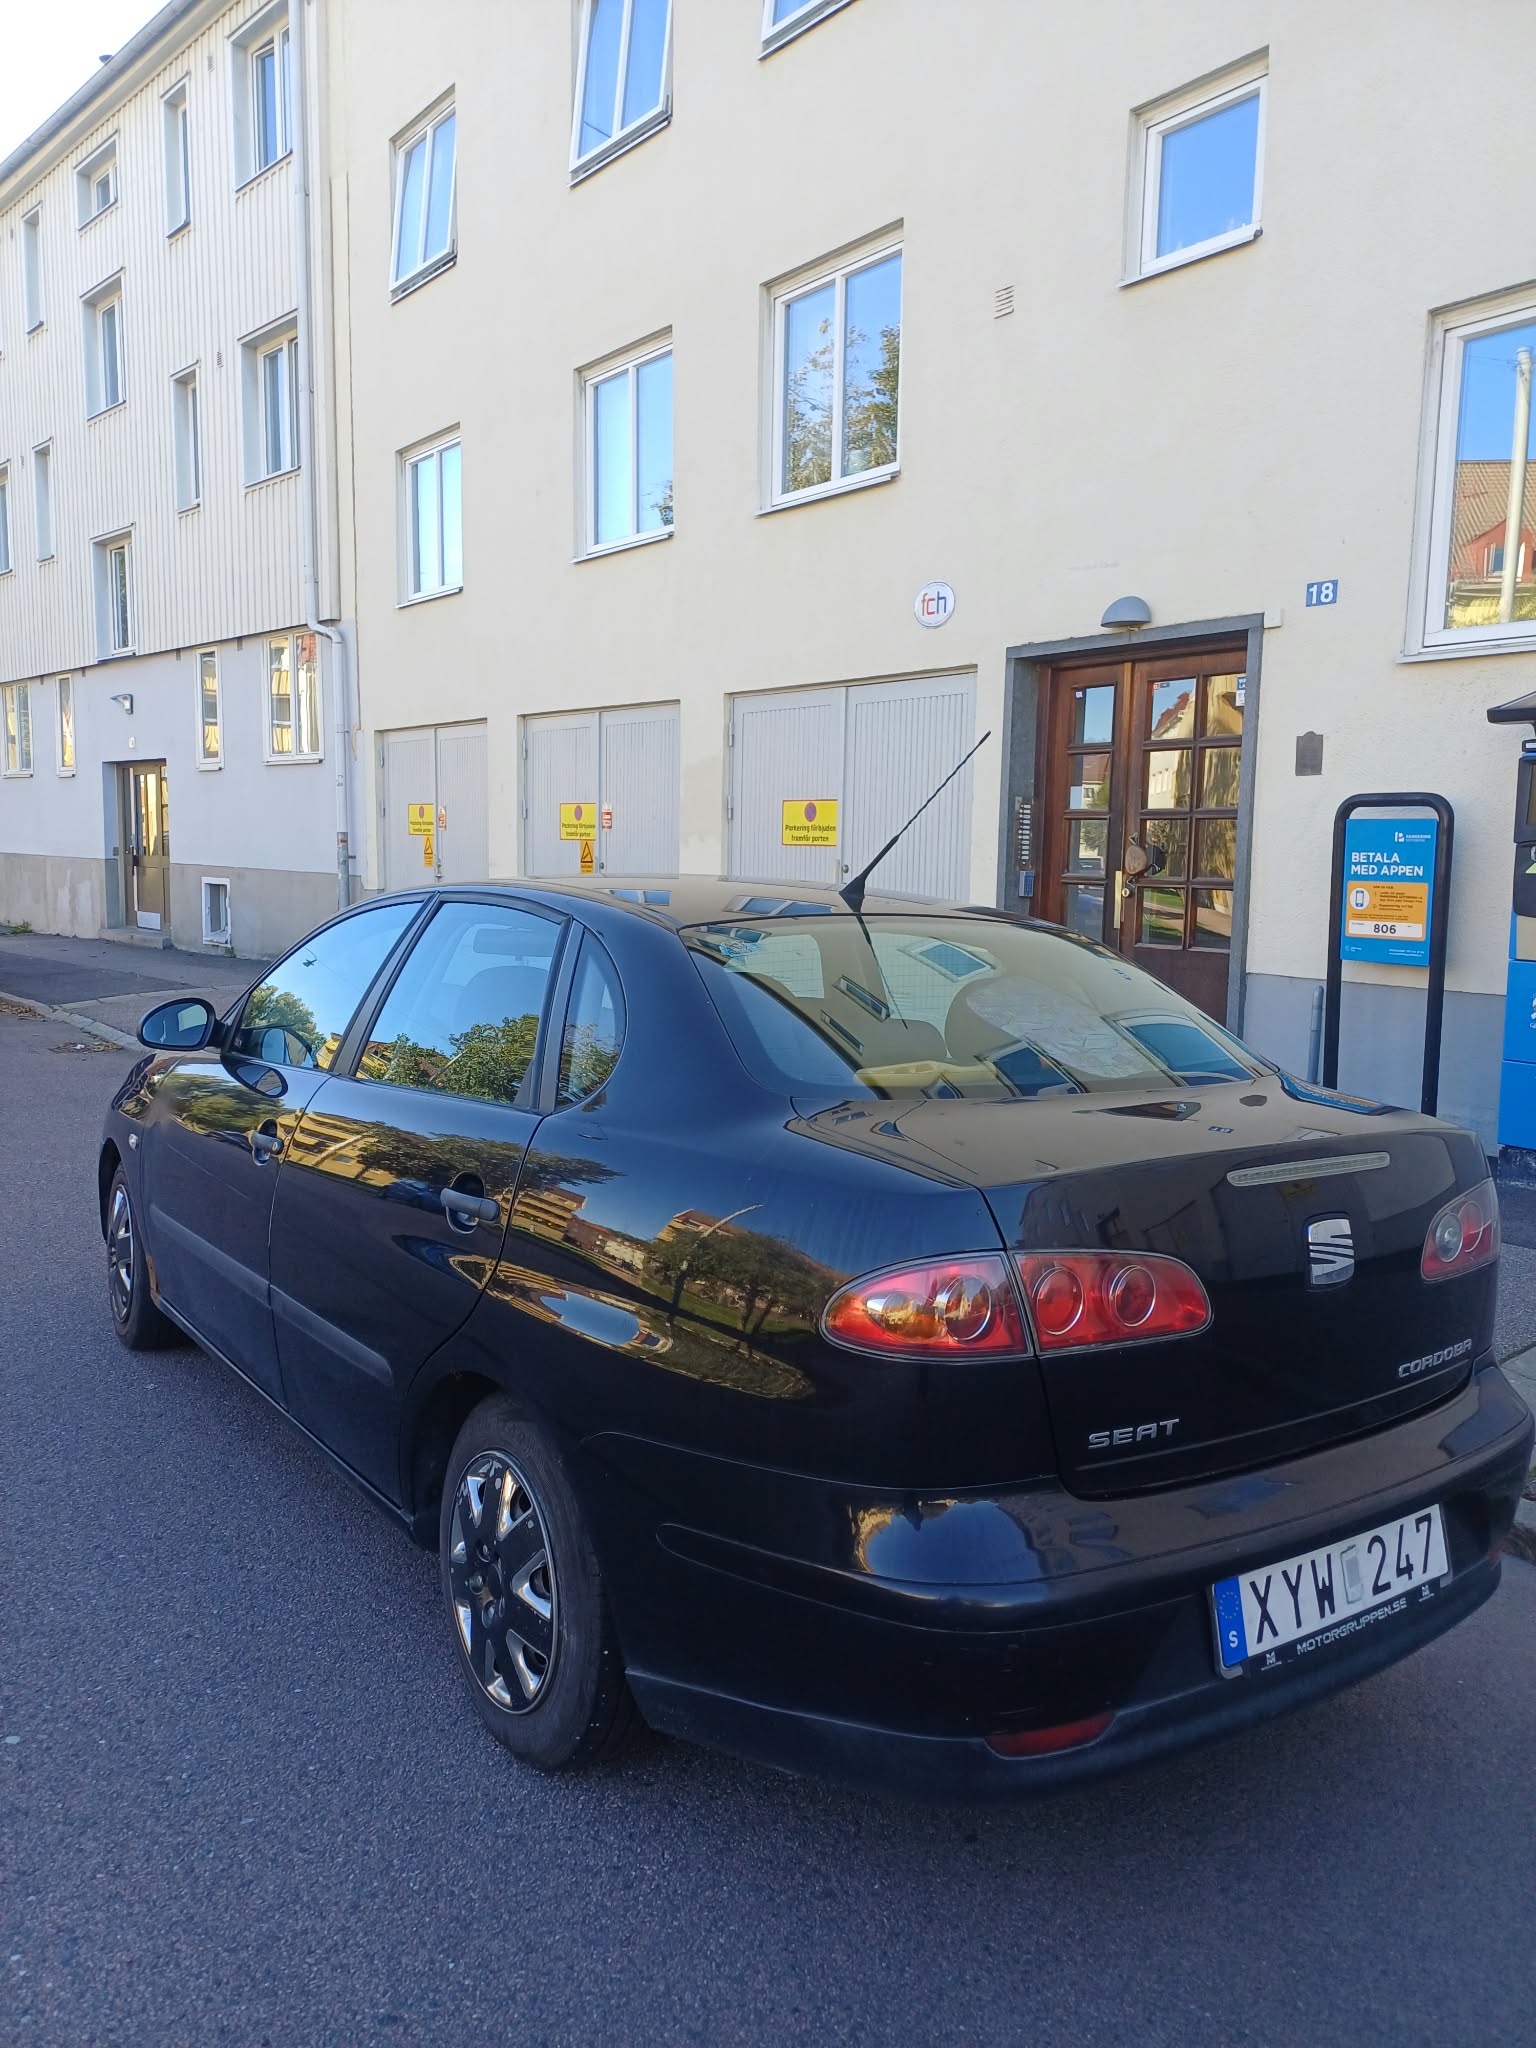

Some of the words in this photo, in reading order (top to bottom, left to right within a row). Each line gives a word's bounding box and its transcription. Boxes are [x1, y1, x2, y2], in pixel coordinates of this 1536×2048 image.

[921, 591, 947, 617] fch
[1309, 582, 1334, 605] 18
[785, 824, 810, 833] Parkering
[1351, 852, 1400, 863] BETALA
[1351, 864, 1378, 875] MED
[1380, 865, 1424, 877] APPEN
[1373, 923, 1397, 934] 806
[1398, 1338, 1472, 1378] CORDOBA
[1088, 1418, 1180, 1450] SEAT
[1249, 1553, 1336, 1645] XYW
[1366, 1512, 1432, 1597] 247
[1296, 1597, 1408, 1656] MOTORGRUPPEN.SE
[1228, 1630, 1239, 1648] S
